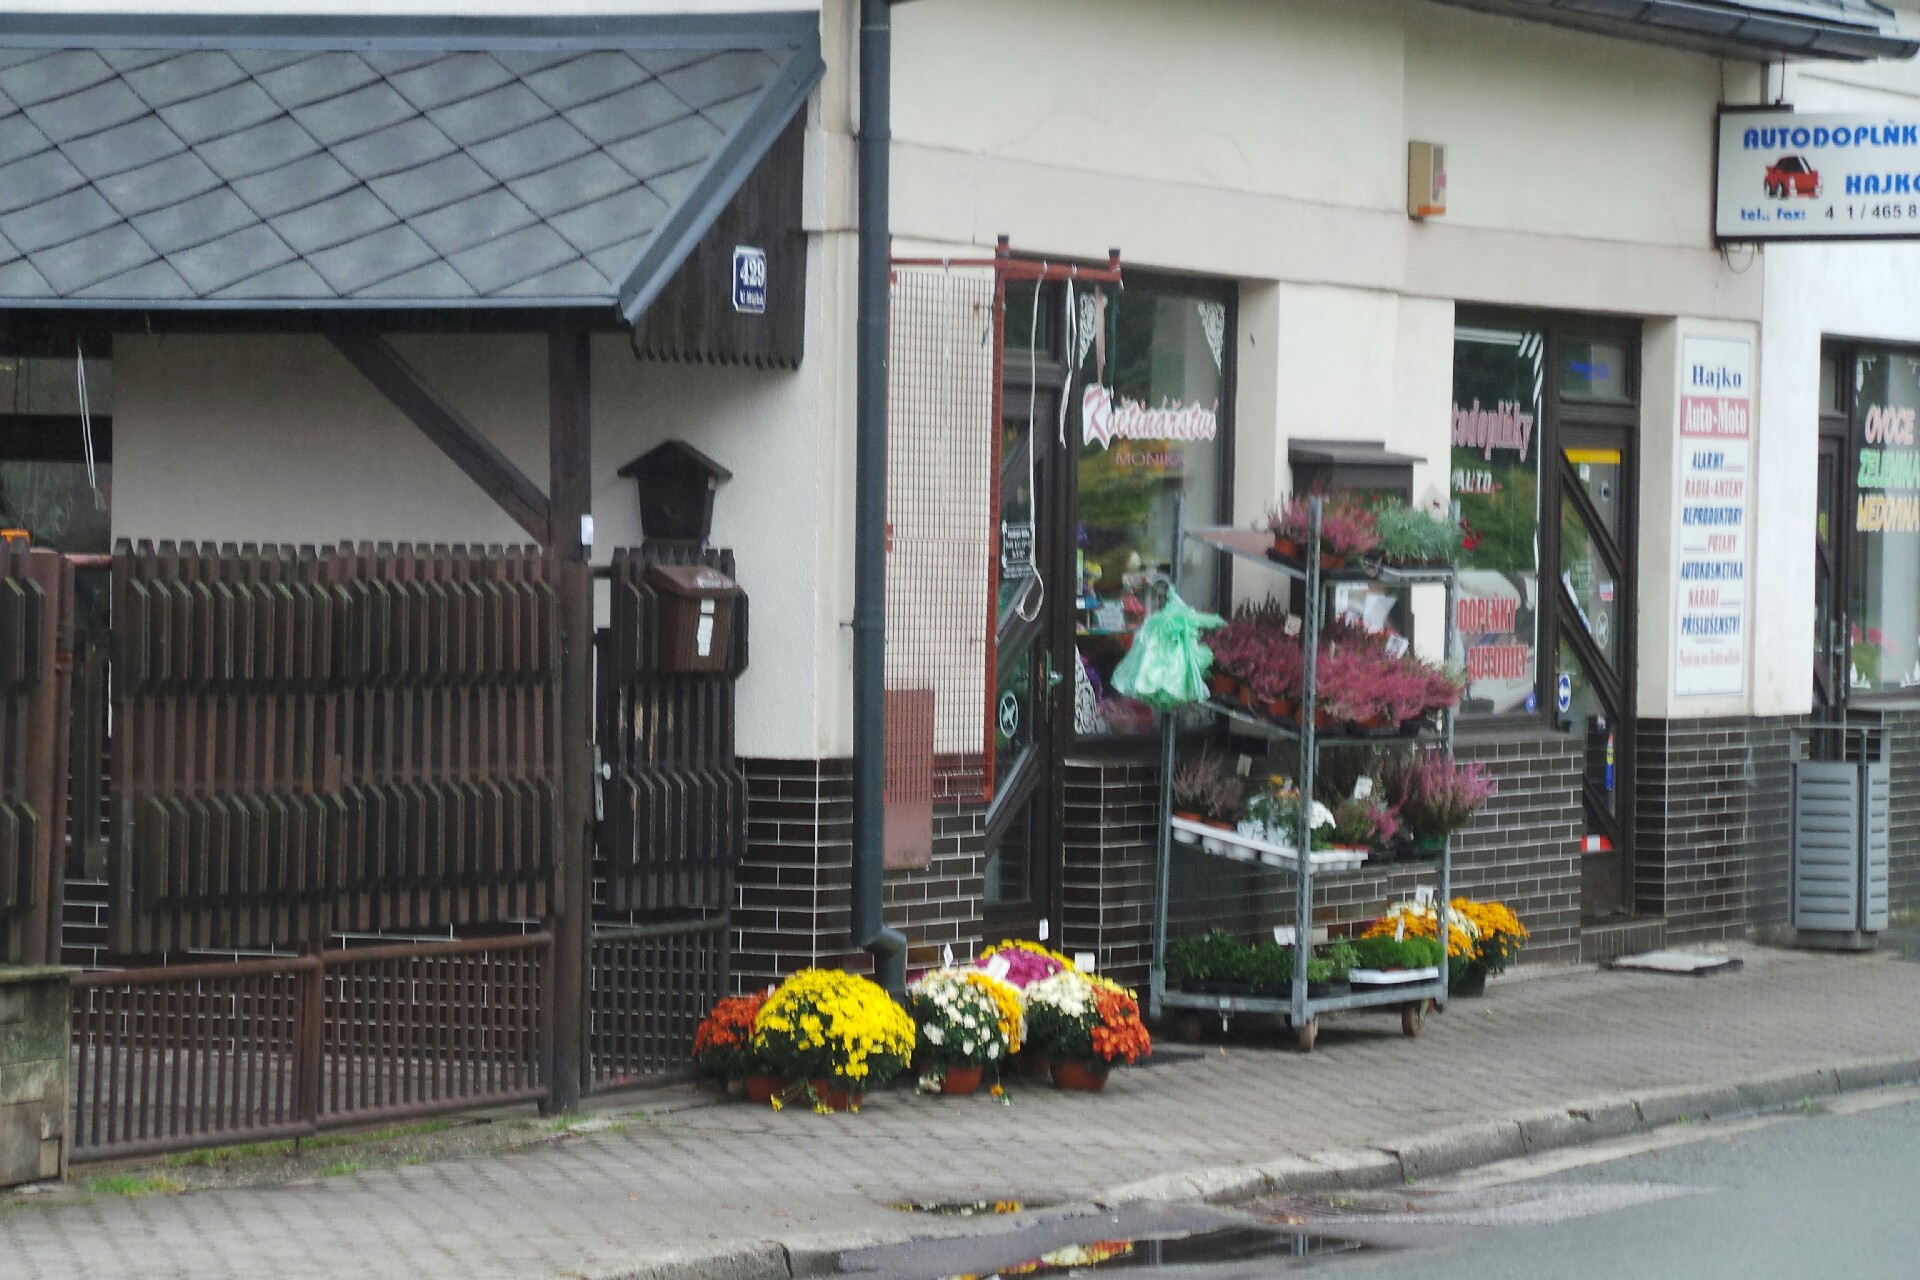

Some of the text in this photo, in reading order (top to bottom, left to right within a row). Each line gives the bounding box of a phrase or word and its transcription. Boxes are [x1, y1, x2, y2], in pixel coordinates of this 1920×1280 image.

[1692, 364, 1742, 392] Hajko
[1865, 404, 1915, 445] OVOCE
[1692, 451, 1724, 471] ALARMY
[1858, 447, 1920, 488] ZELENINA
[1683, 507, 1743, 526] REPRODUKTORY
[1857, 493, 1919, 532] MEDOVINA
[1708, 534, 1738, 554] POTAHY
[1457, 592, 1516, 633] DOPLŇKY
